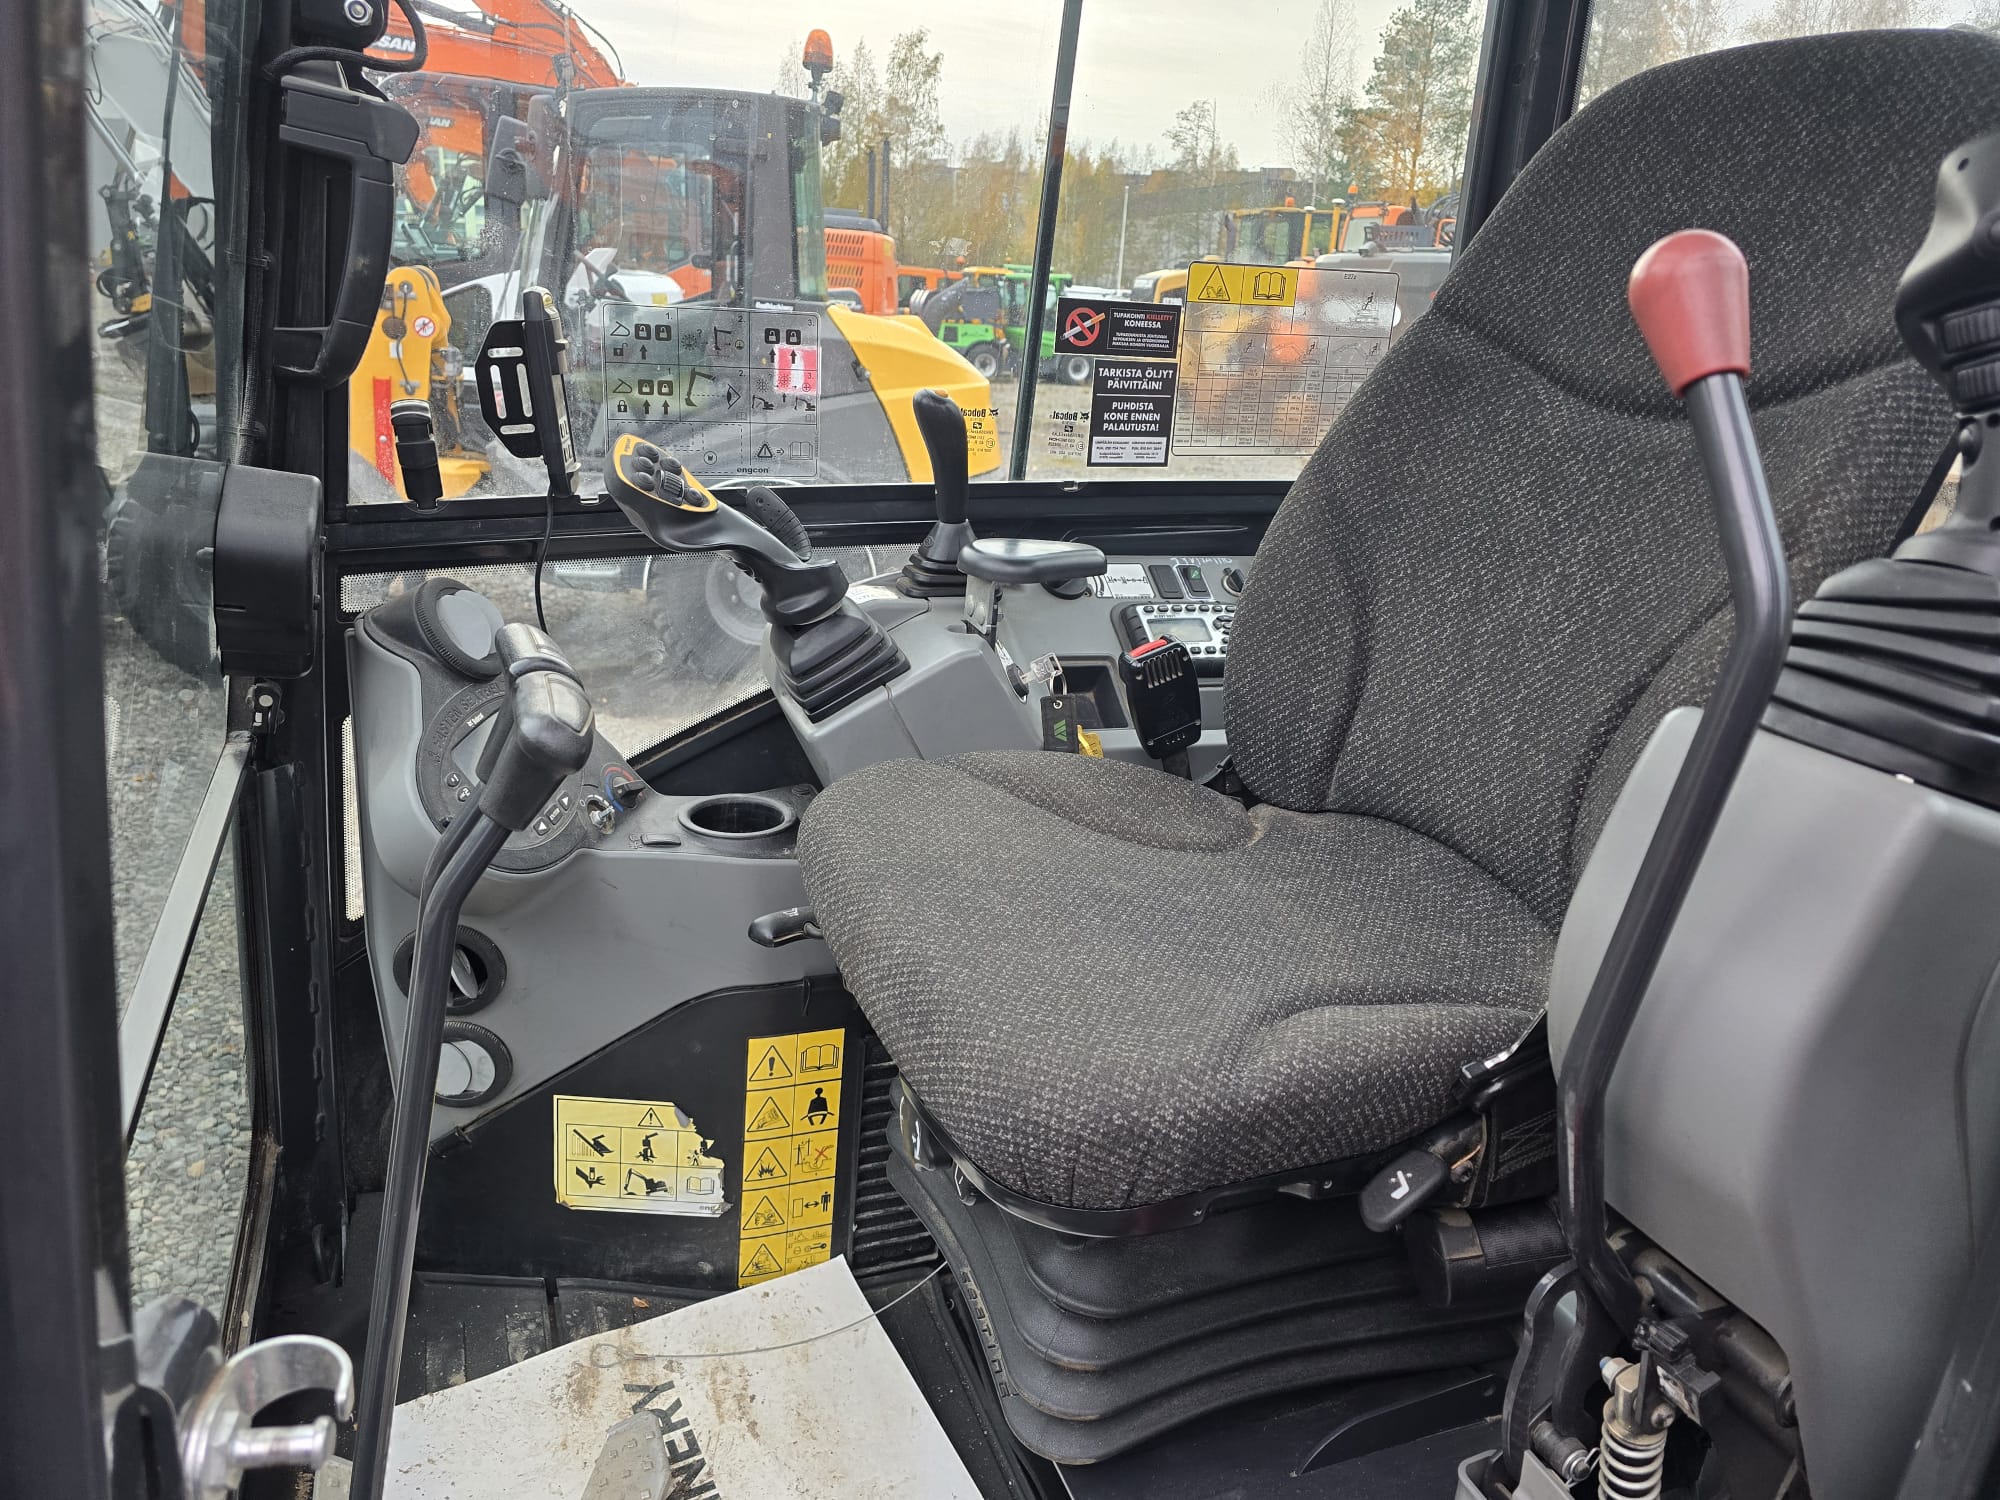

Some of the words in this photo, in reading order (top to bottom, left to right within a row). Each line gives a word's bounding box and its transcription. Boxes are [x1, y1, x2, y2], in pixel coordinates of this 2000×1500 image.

[1113, 312, 1146, 320] TUPAKOINTI
[1146, 313, 1174, 321] KIELLETTY
[1124, 319, 1162, 329] KONEESSA
[1098, 367, 1143, 378] TARKISTA
[1145, 367, 1174, 379] ÖLJYT
[1107, 378, 1163, 390] PÄIVITTÄIN!
[1111, 401, 1154, 411] PUHDISTA
[1103, 412, 1129, 421] KONE
[1130, 413, 1161, 421] ENNEN
[1103, 422, 1160, 432] PALAUTUSTA!
[736, 467, 769, 475] engcon
[623, 1380, 721, 1500] NERY
